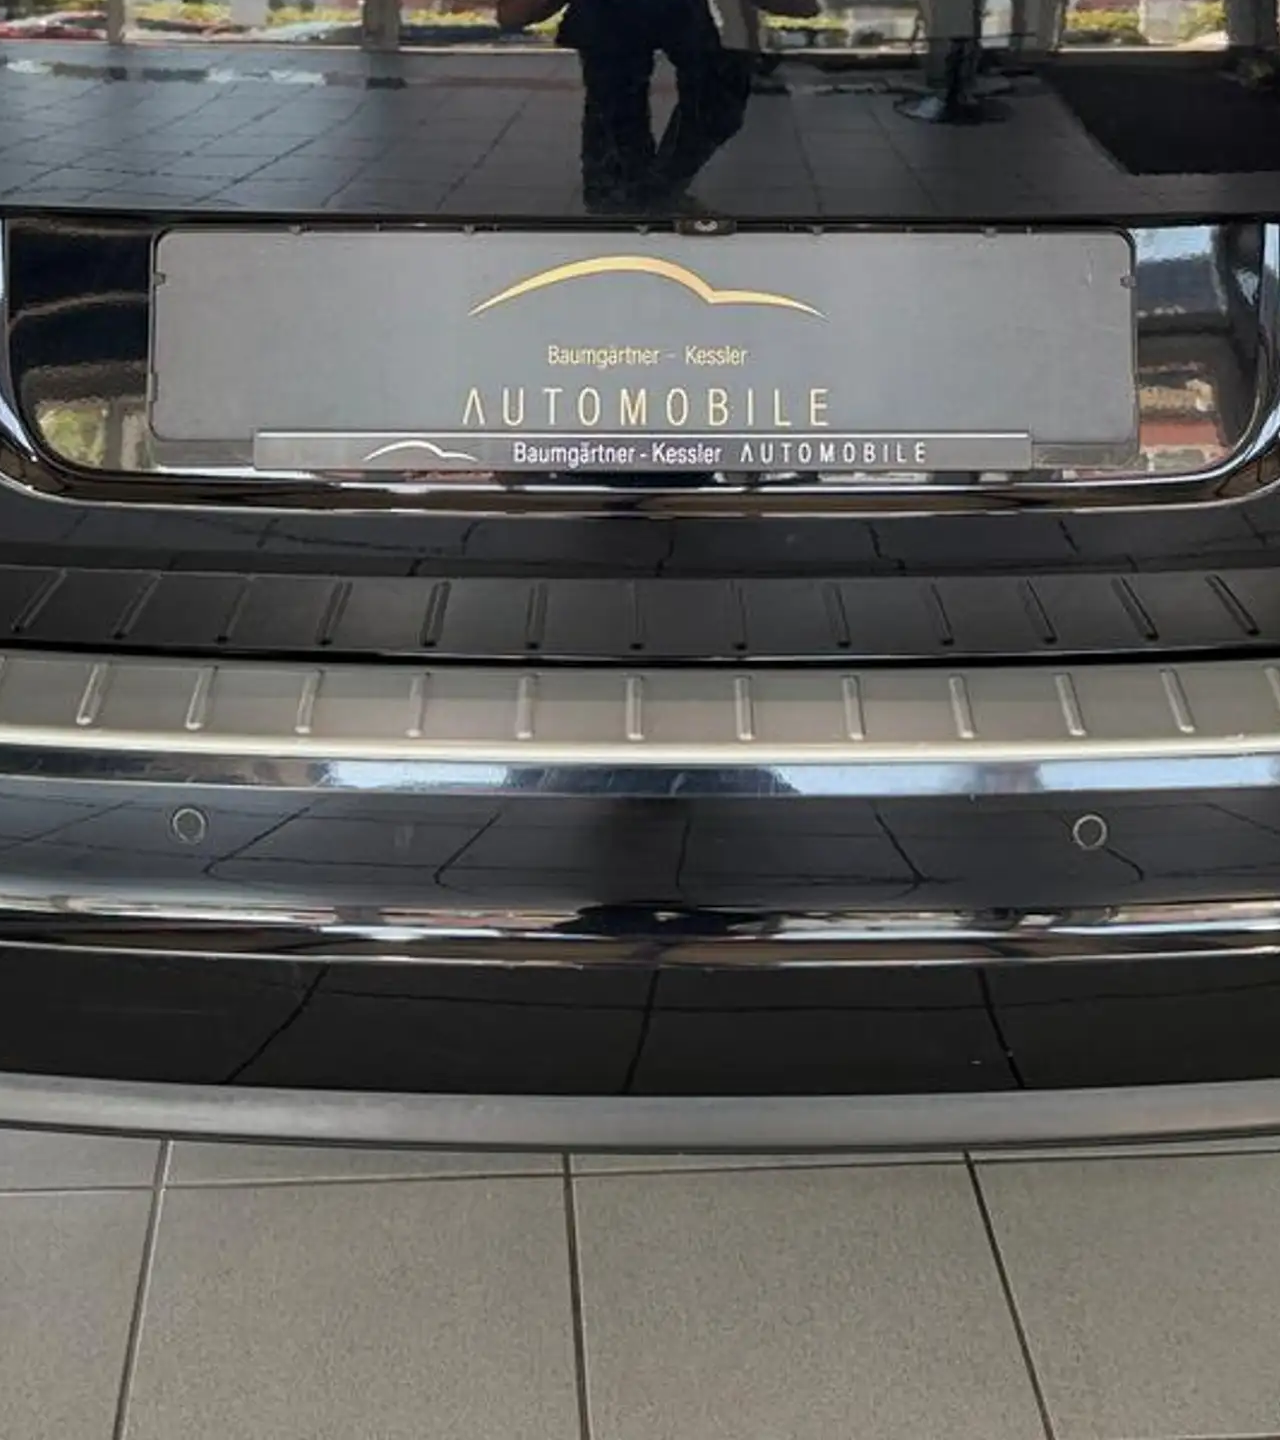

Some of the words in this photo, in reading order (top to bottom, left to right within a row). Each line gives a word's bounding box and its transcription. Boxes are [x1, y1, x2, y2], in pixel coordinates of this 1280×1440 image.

[547, 345, 660, 369] Baumgärtner
[684, 345, 747, 366] Kessler
[462, 387, 829, 427] AUTOMOBILE
[513, 442, 634, 468] Baumgärtner
[651, 442, 722, 463] Kessler
[740, 442, 926, 463] AUTOMOBILE
